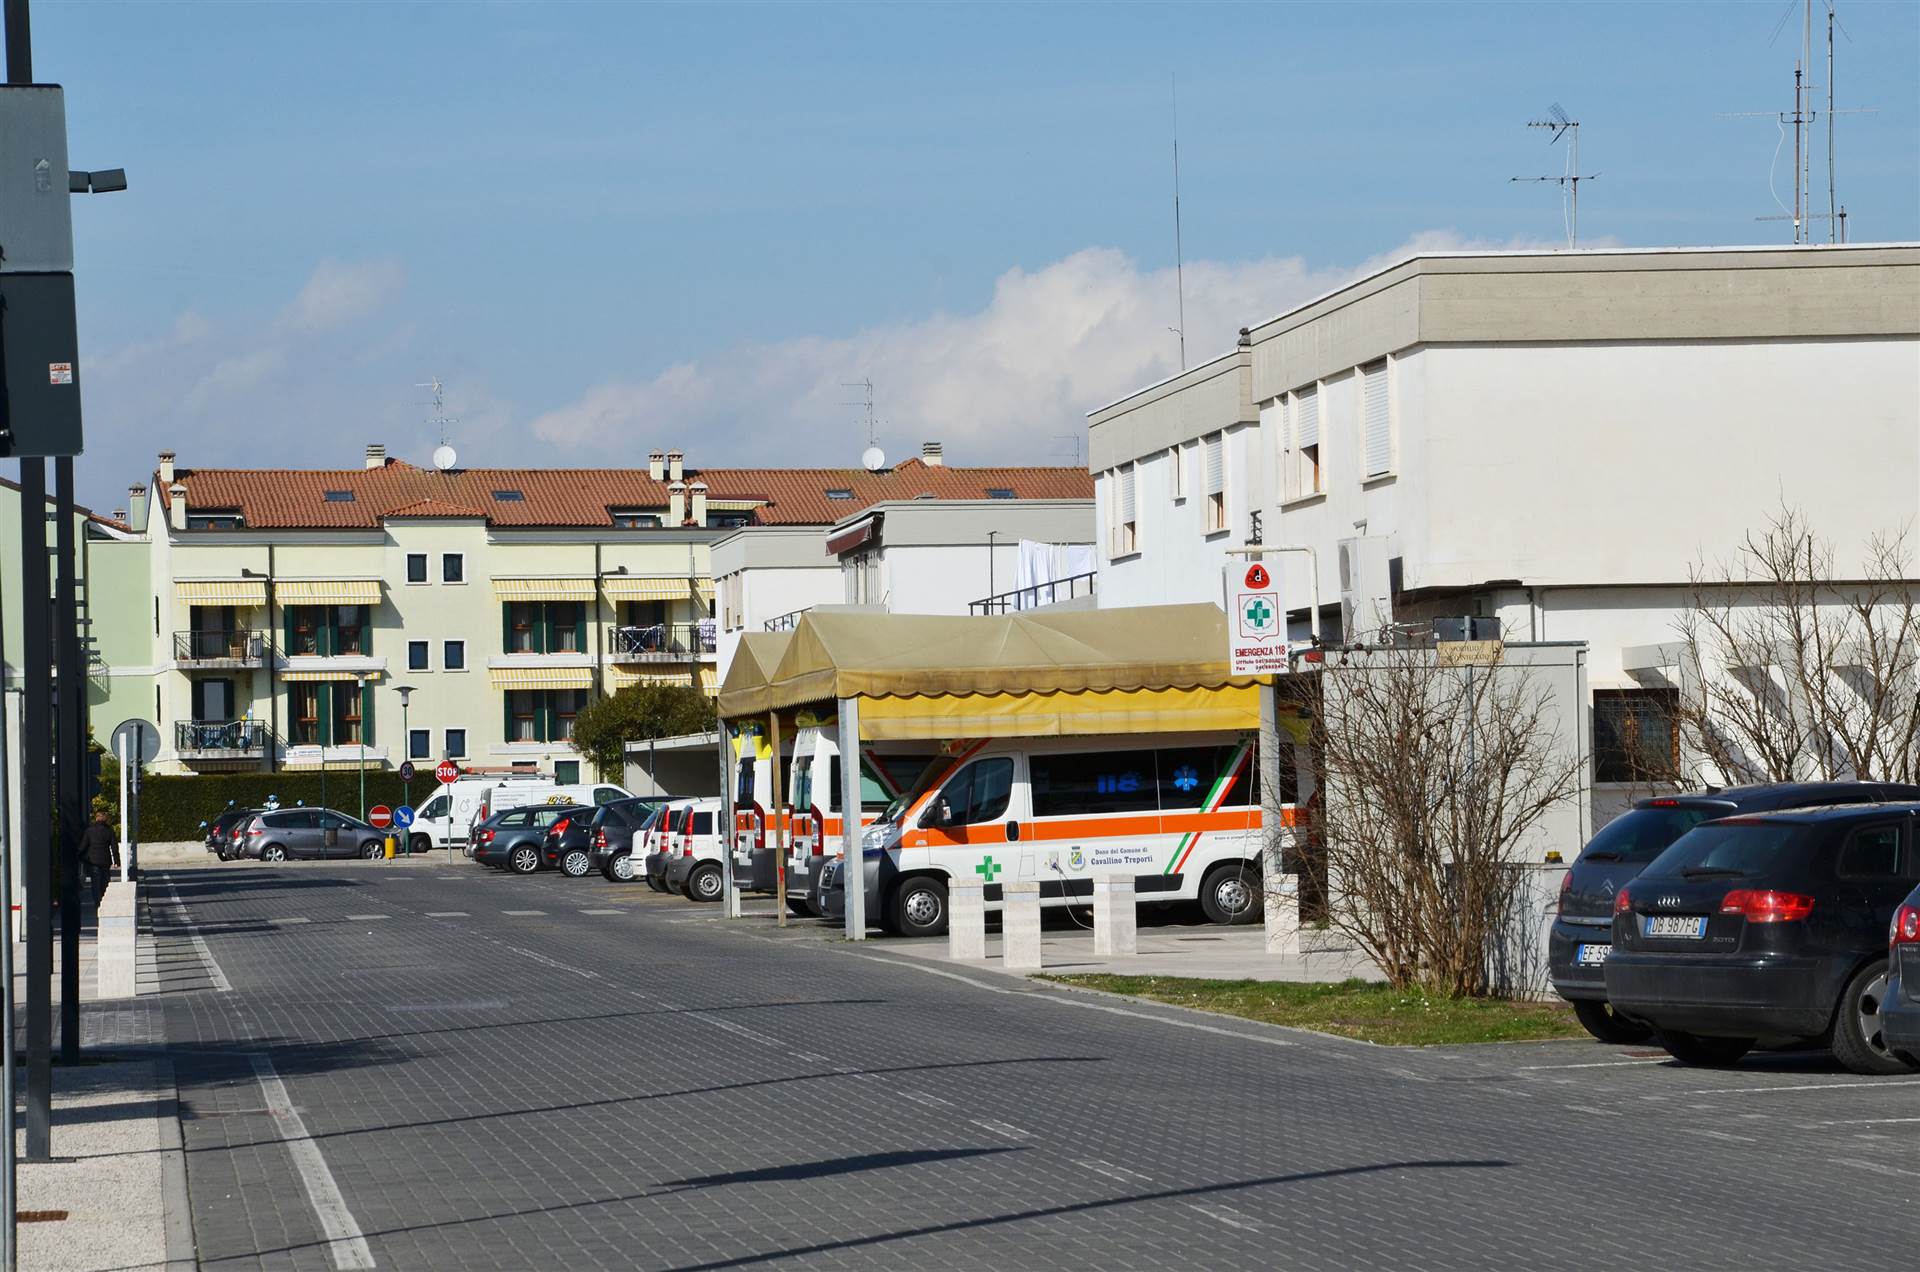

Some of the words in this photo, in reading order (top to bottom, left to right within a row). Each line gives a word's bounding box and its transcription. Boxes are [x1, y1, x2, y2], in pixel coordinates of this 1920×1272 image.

[1235, 647, 1273, 657] EMERGENZA
[1274, 645, 1286, 656] 118
[403, 766, 412, 777] 30
[437, 767, 457, 777] STOP
[1090, 857, 1123, 865] Cavallino
[1124, 855, 1153, 864] Treporti
[1652, 917, 1665, 933] DB
[1667, 917, 1700, 934] 987FG
[1583, 946, 1595, 960] EF
